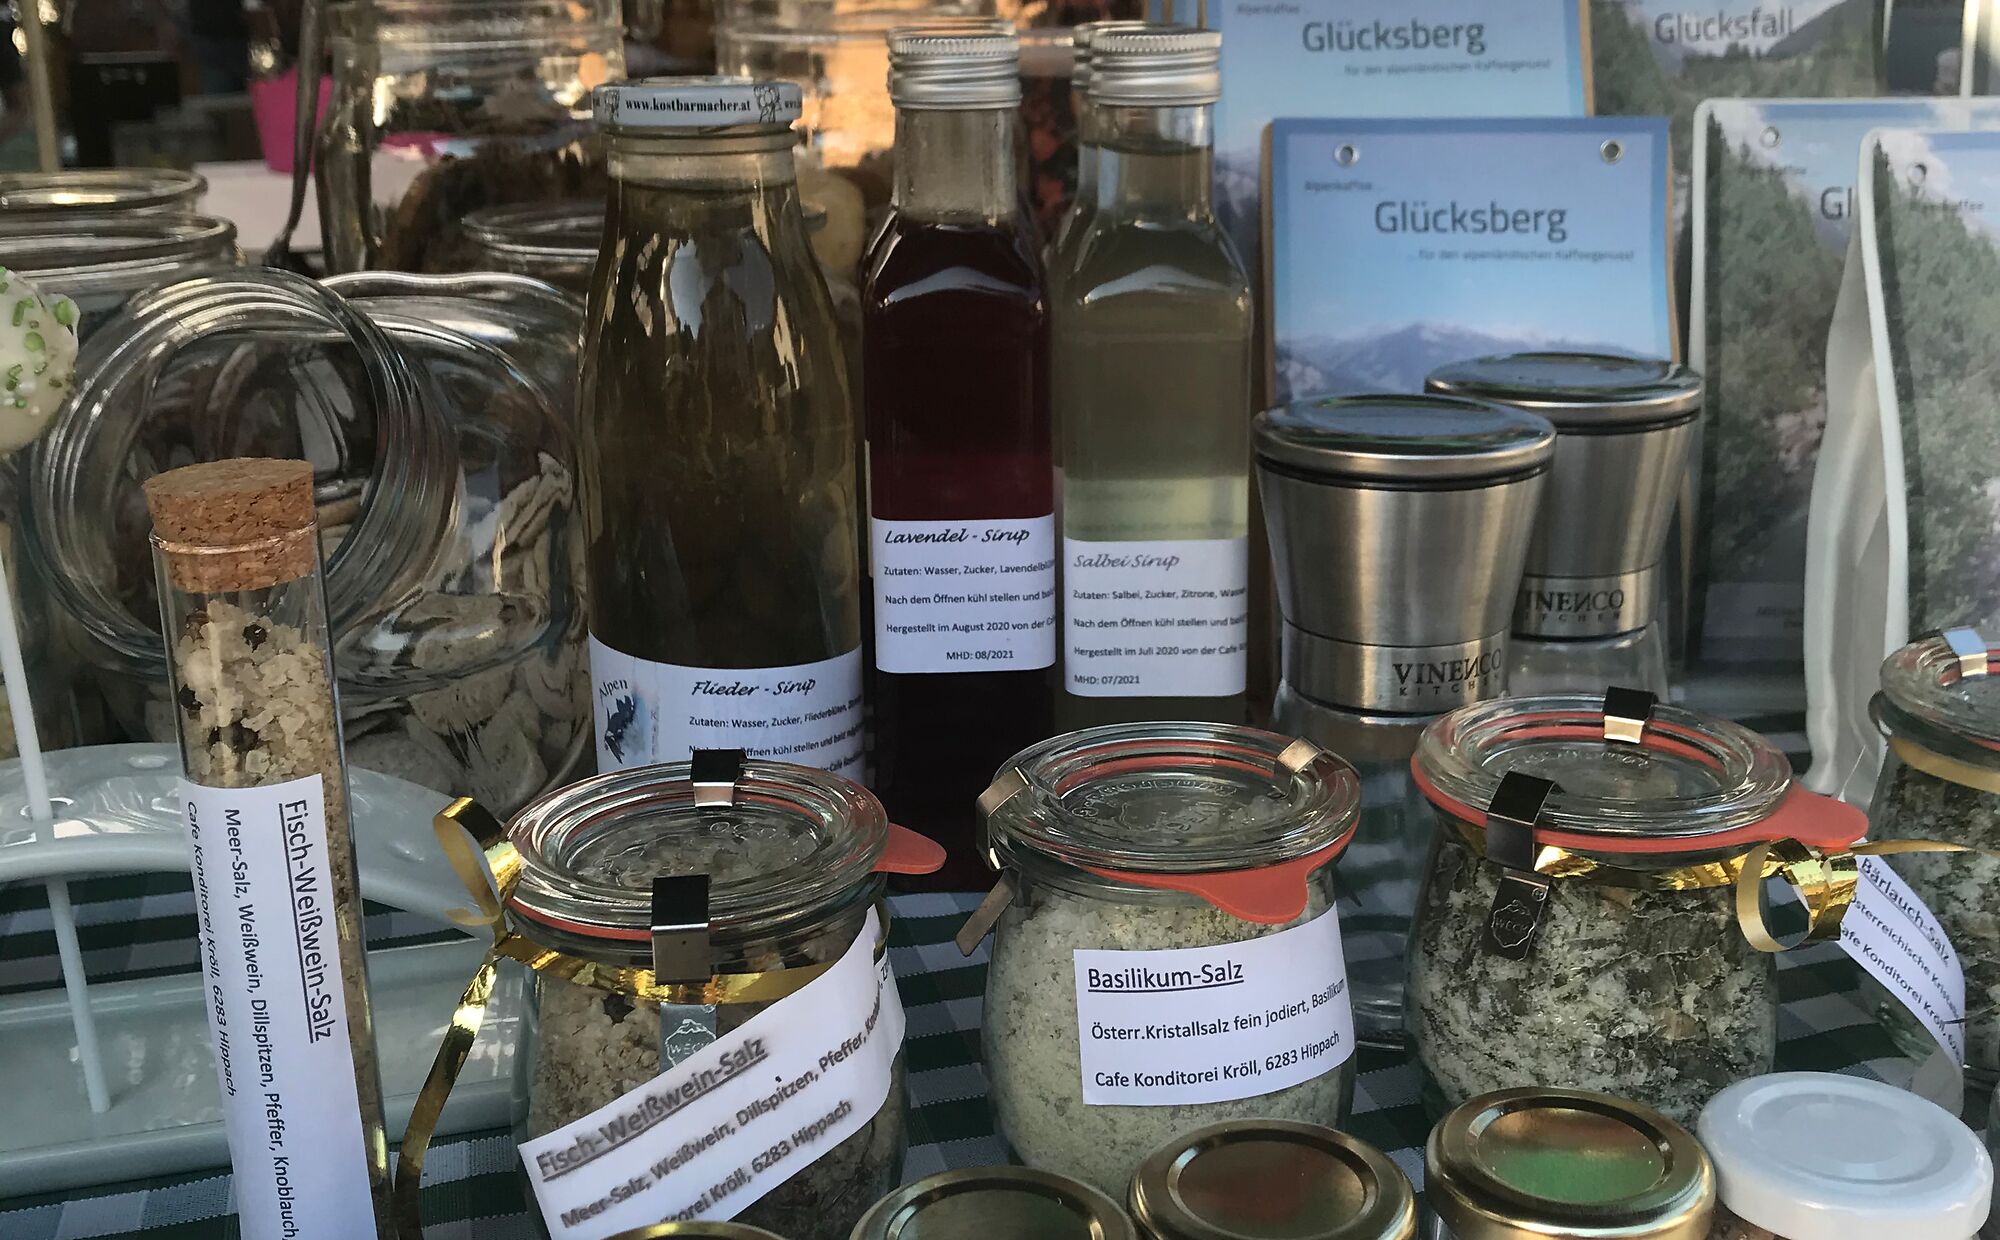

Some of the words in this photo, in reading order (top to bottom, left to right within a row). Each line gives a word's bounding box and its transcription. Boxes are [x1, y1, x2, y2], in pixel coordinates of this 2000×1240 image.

[1302, 18, 1486, 55] Glücksberg
[1654, 8, 1793, 44] Glücksfall
[625, 98, 751, 112] www.kostbarmacher.at
[1374, 201, 1568, 243] Glücksberg
[885, 528, 968, 544] Lavendel
[981, 529, 1031, 546] Sirup
[884, 566, 922, 576] Zutaten:
[924, 565, 962, 576] Wasser,
[963, 565, 998, 575] Zucker,
[1073, 554, 1130, 568] Salbei
[1131, 554, 1180, 571] Sirup
[885, 595, 908, 605] Nach
[910, 595, 931, 604] dem
[933, 593, 965, 604] Öffnen
[967, 594, 988, 603] kühl
[990, 593, 1020, 602] stellen
[1022, 592, 1040, 601] und
[1073, 590, 1110, 600] Zutaten:
[1112, 590, 1141, 601] Salbei,
[1145, 590, 1178, 600] Zucker,
[1181, 589, 1217, 600] Zitrone,
[886, 623, 936, 635] Hergestellt
[938, 624, 950, 633] im
[952, 623, 984, 634] August
[986, 622, 1010, 631] 2020
[1012, 622, 1029, 631] von
[1031, 620, 1044, 630] der
[1073, 618, 1096, 628] Nach
[1097, 618, 1118, 628] dem
[1121, 618, 1152, 628] Öffnen
[1155, 618, 1174, 627] kühl
[1177, 618, 1207, 627] stellen
[1210, 617, 1228, 627] und
[946, 651, 973, 660] MHD:
[975, 650, 1014, 660] 08/2021
[1074, 647, 1122, 658] Hergestellt
[1125, 647, 1136, 656] im
[1138, 646, 1153, 656] Juli
[1156, 646, 1179, 655] 2020
[1181, 647, 1199, 655] von
[1201, 646, 1216, 655] der
[599, 679, 629, 697] Alpen
[691, 680, 759, 697] Flieder
[772, 678, 816, 698] Sirup
[1074, 675, 1100, 684] MHD:
[1101, 674, 1140, 685] 07/2021
[689, 716, 729, 728] Zutaten:
[732, 716, 769, 729] Wasser,
[771, 714, 803, 727] Zucker,
[741, 746, 771, 757] ffnen
[773, 745, 791, 755] kühl
[793, 740, 820, 753] stellen
[820, 735, 833, 748] und
[187, 801, 200, 840] Cafe
[193, 843, 214, 935] Konditorei
[284, 799, 336, 1042] Fisch-Weißwein-Salz
[1861, 857, 1951, 964] Bärlauch-Salz
[206, 936, 220, 979] Kröll,
[1087, 960, 1244, 990] Basilikum-Salz
[1862, 943, 1923, 1004] Konditorei
[224, 808, 252, 899] Meer-Salz,
[238, 903, 264, 995] Weißwein,
[251, 999, 275, 1088] Dillspitzen,
[263, 1092, 285, 1152] Pfeffer,
[212, 984, 227, 1027] 6283
[1091, 1018, 1230, 1041] Österr.Kristallsalz
[1233, 1013, 1262, 1031] fein
[1265, 998, 1310, 1028] jodiert,
[217, 1029, 237, 1097] Hippach
[1095, 1071, 1130, 1087] Cafe
[1134, 1066, 1218, 1088] Konditorei
[1223, 1060, 1262, 1078] Kröll,
[1265, 1049, 1299, 1071] 6283
[1301, 1030, 1340, 1060] Hippach
[536, 1037, 767, 1178] Fisch-Weißwein-Salz
[560, 1175, 652, 1229] Meer-Salz,
[650, 1121, 736, 1180] Weißwein,
[735, 1069, 820, 1127] Dillspitzen,
[818, 1031, 867, 1073] Pfeffer,
[709, 1167, 752, 1202] Kröll,
[751, 1140, 792, 1174] 6283
[791, 1099, 853, 1149] Hippach
